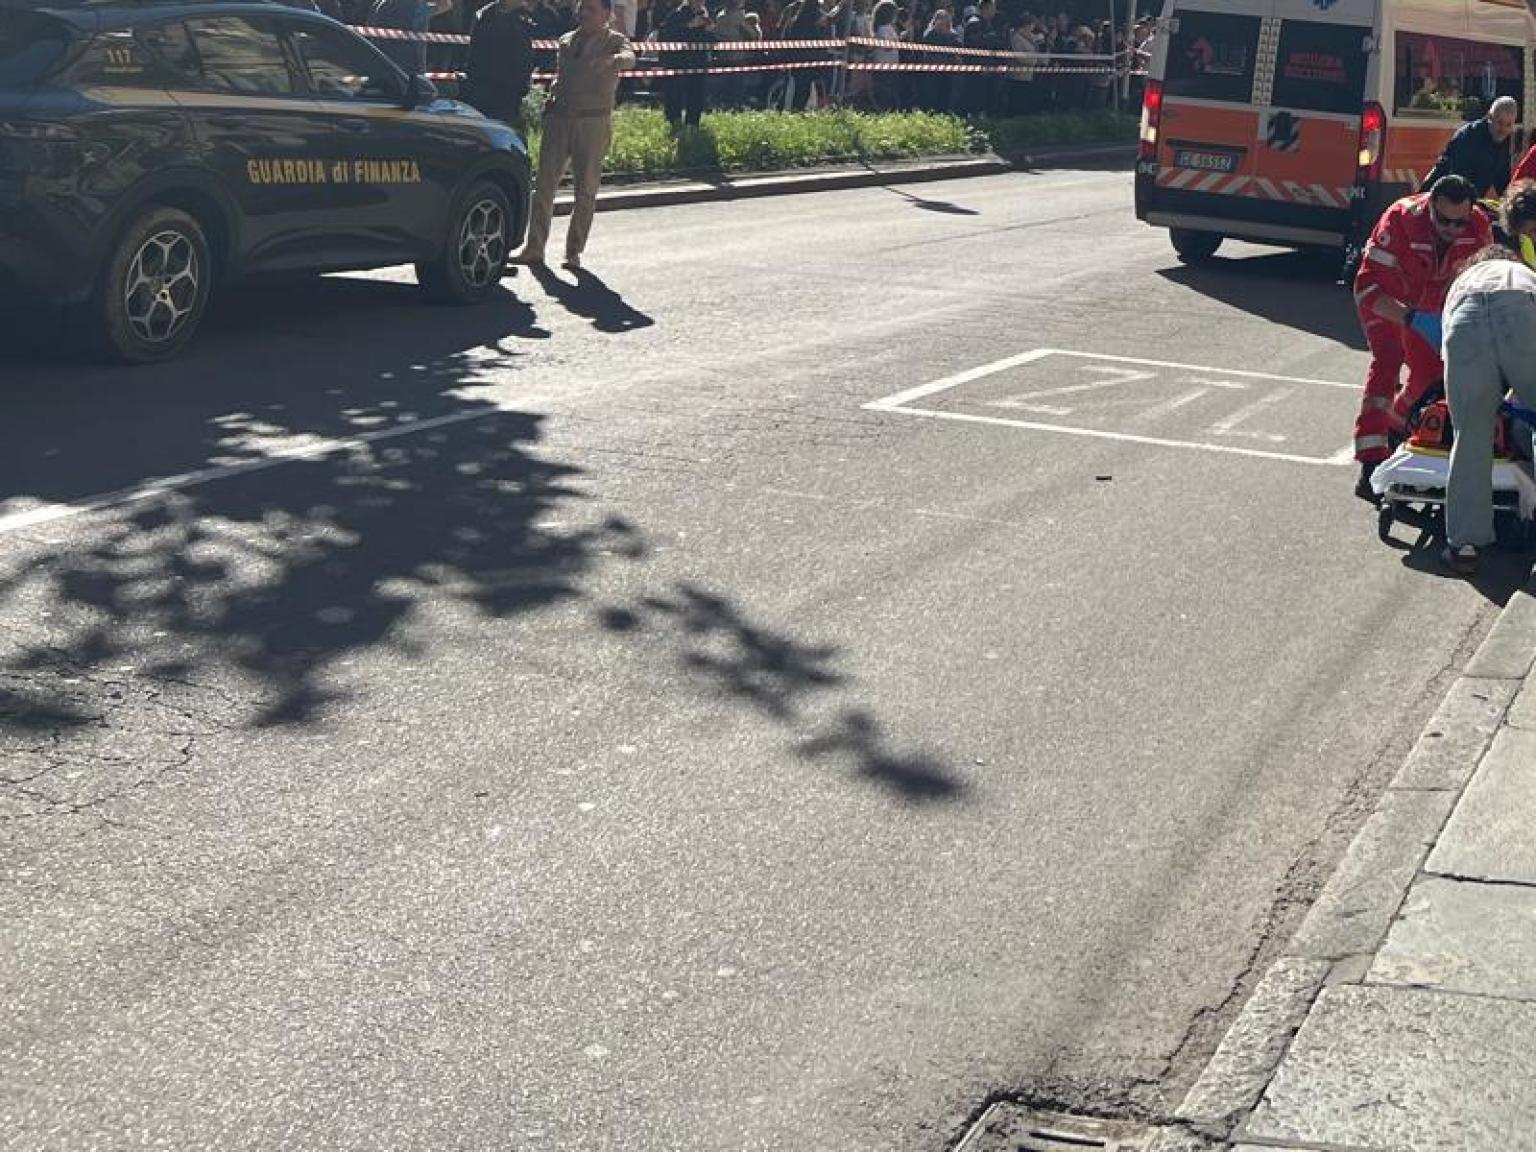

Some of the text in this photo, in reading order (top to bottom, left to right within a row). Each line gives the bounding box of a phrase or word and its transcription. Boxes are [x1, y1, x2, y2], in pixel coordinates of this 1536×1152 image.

[247, 159, 421, 184] GUARDIA di FINANZA
